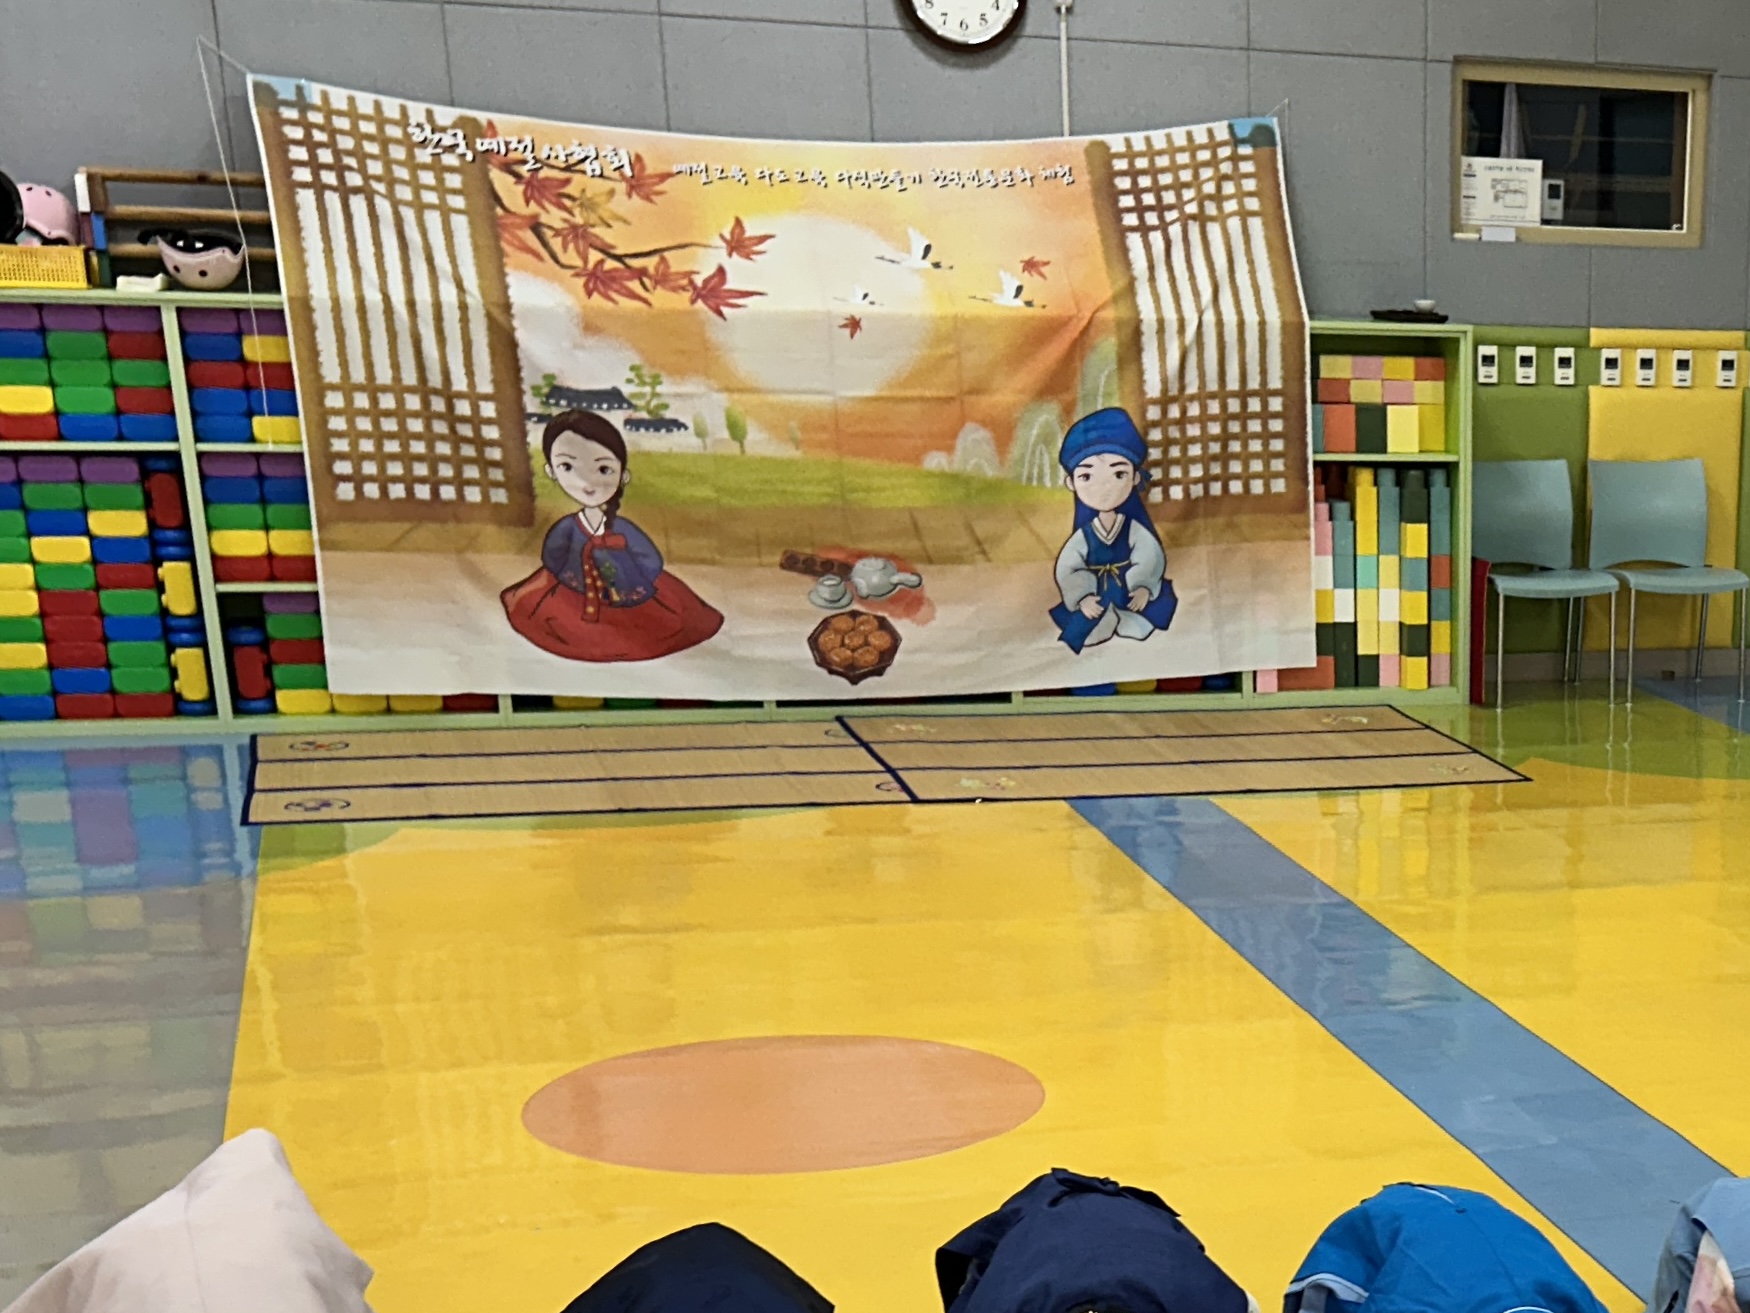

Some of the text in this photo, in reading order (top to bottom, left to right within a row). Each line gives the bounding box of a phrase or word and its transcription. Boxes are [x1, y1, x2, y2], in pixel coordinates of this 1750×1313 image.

[940, 12, 948, 26] 7
[959, 18, 969, 31] 6
[979, 13, 989, 27] 5
